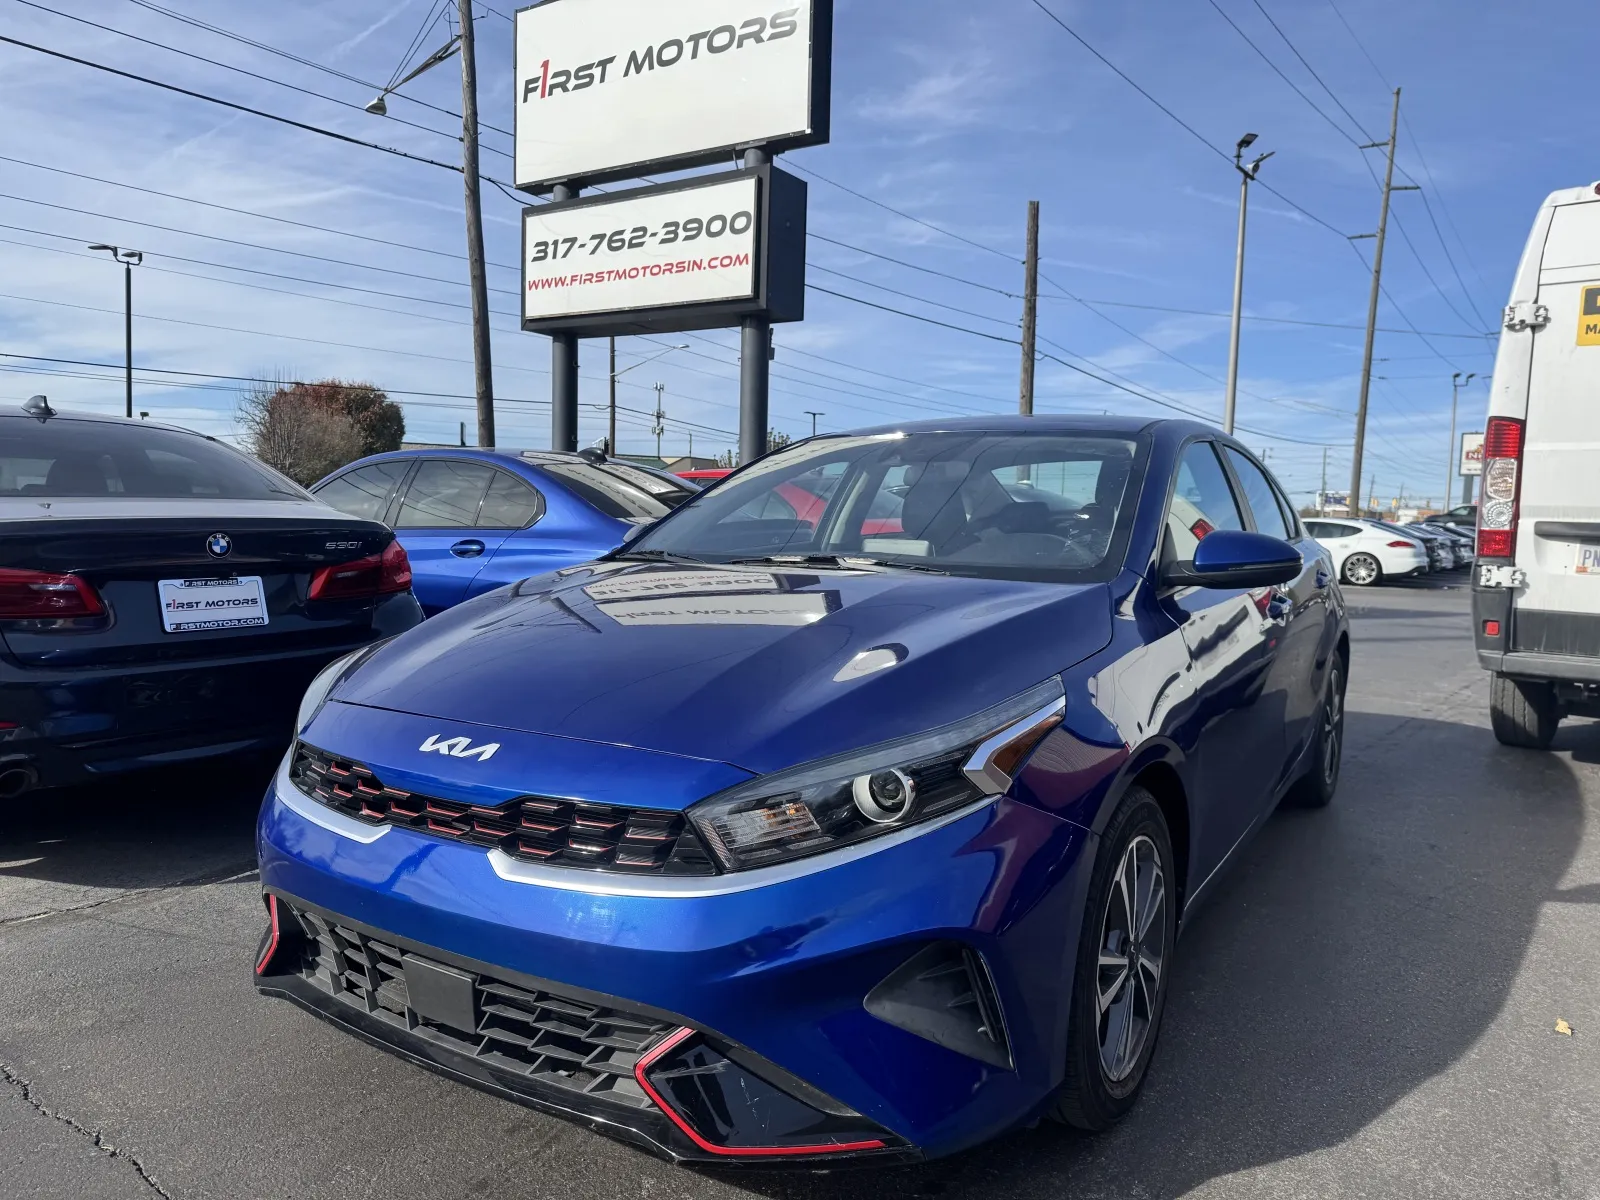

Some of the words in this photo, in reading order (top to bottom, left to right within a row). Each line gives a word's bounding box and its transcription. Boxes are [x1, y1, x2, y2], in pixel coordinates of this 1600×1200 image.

[622, 7, 800, 78] MOTORS
[531, 210, 753, 262] 317-762-3900
[528, 253, 749, 291] WWW.FIRSTMOTORSIN.COM
[205, 598, 258, 608] MOTORS
